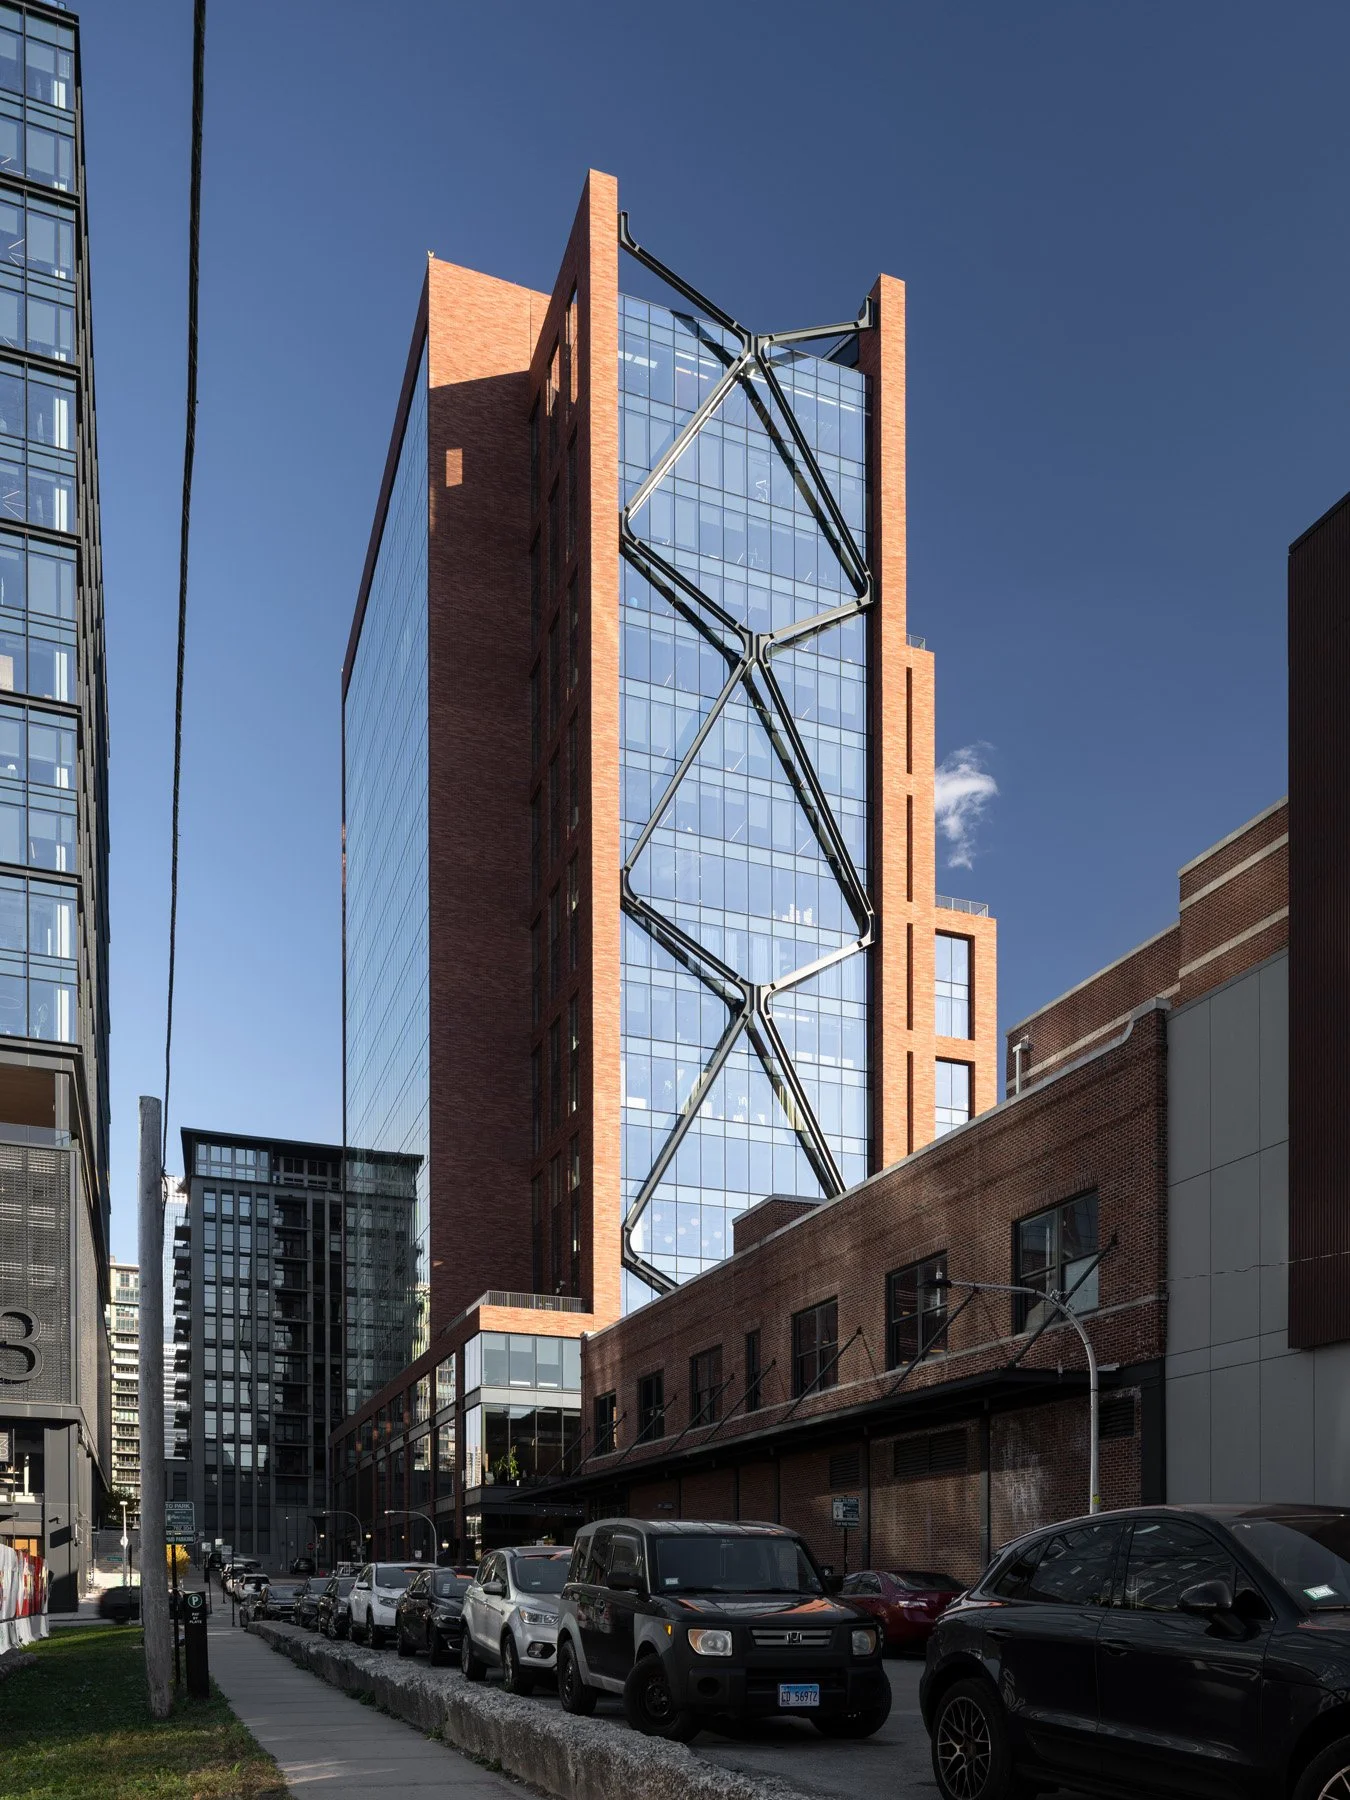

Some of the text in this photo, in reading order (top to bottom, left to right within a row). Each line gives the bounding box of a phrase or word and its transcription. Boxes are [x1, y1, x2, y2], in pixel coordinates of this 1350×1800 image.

[0, 1305, 43, 1381] 3
[192, 1596, 199, 1606] P
[782, 1691, 817, 1702] CD 56972
